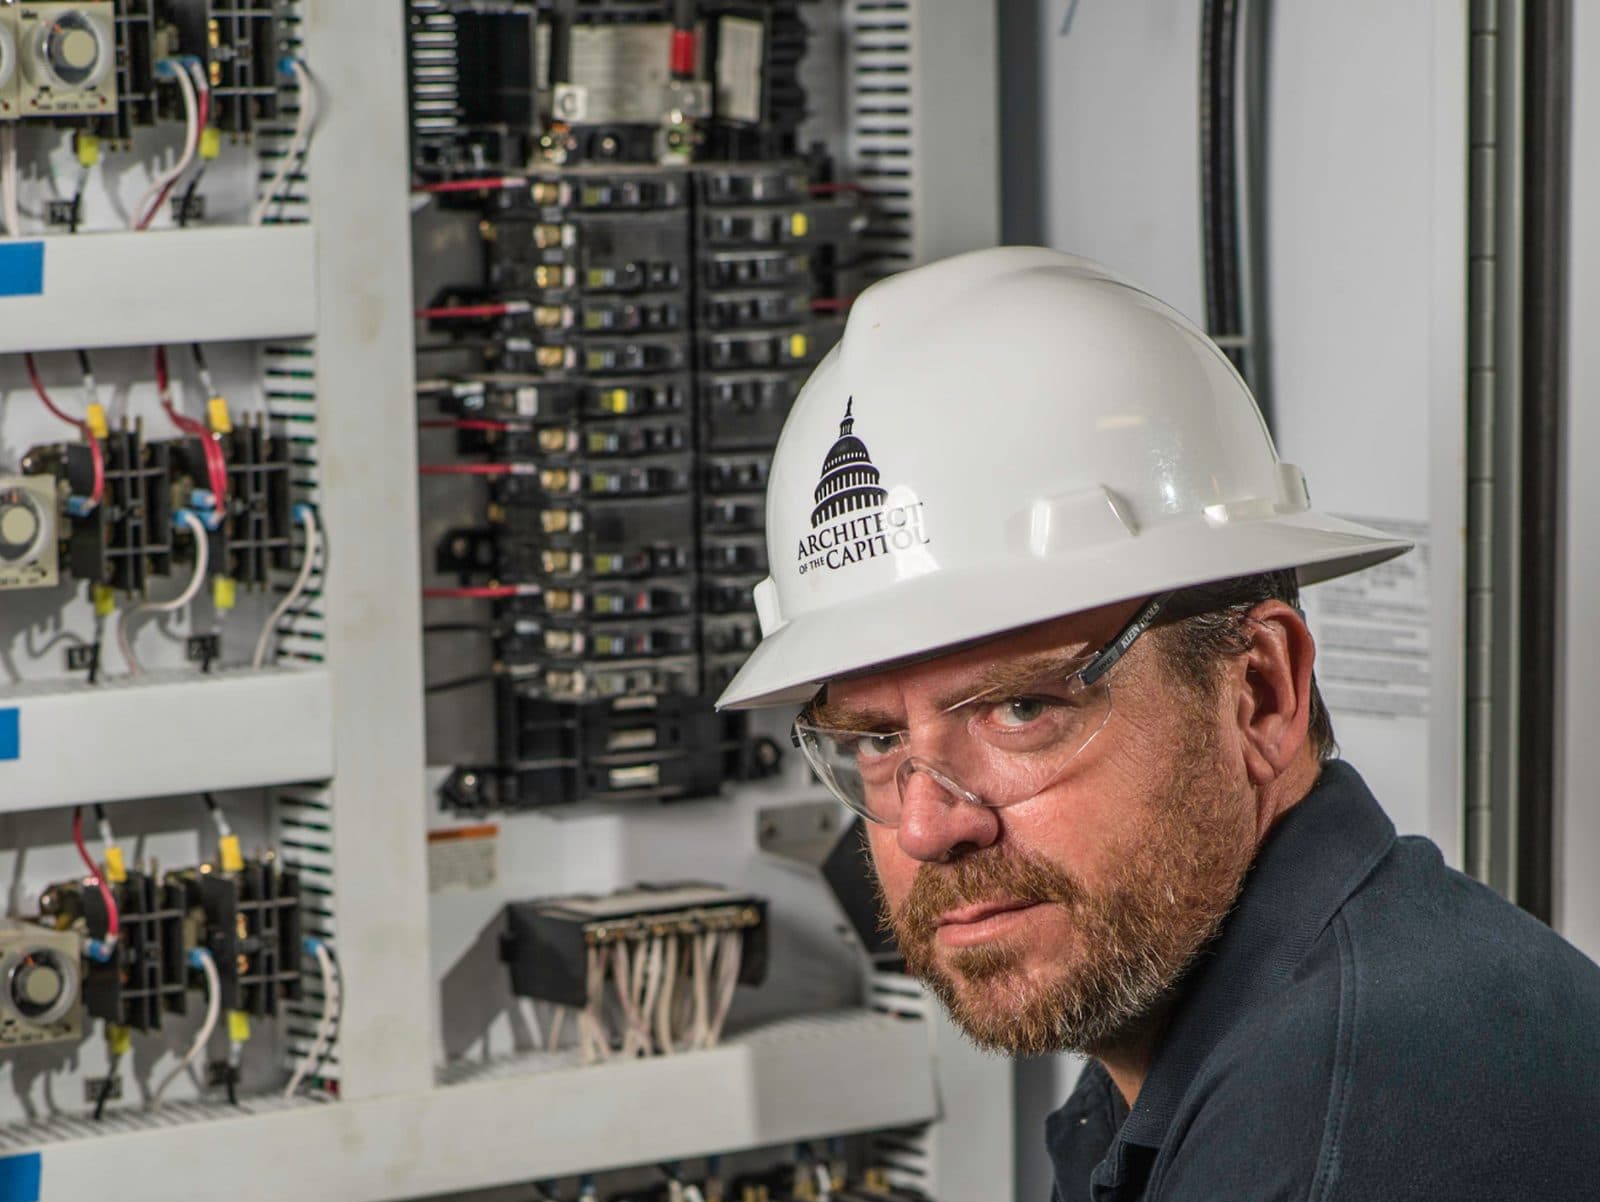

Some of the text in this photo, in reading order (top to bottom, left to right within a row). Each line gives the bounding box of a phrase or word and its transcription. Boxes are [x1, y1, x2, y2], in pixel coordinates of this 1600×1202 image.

[797, 502, 924, 561] ARCHITECT
[799, 525, 931, 574] OF THE CAPITOL
[1121, 624, 1140, 649] KLEIN
